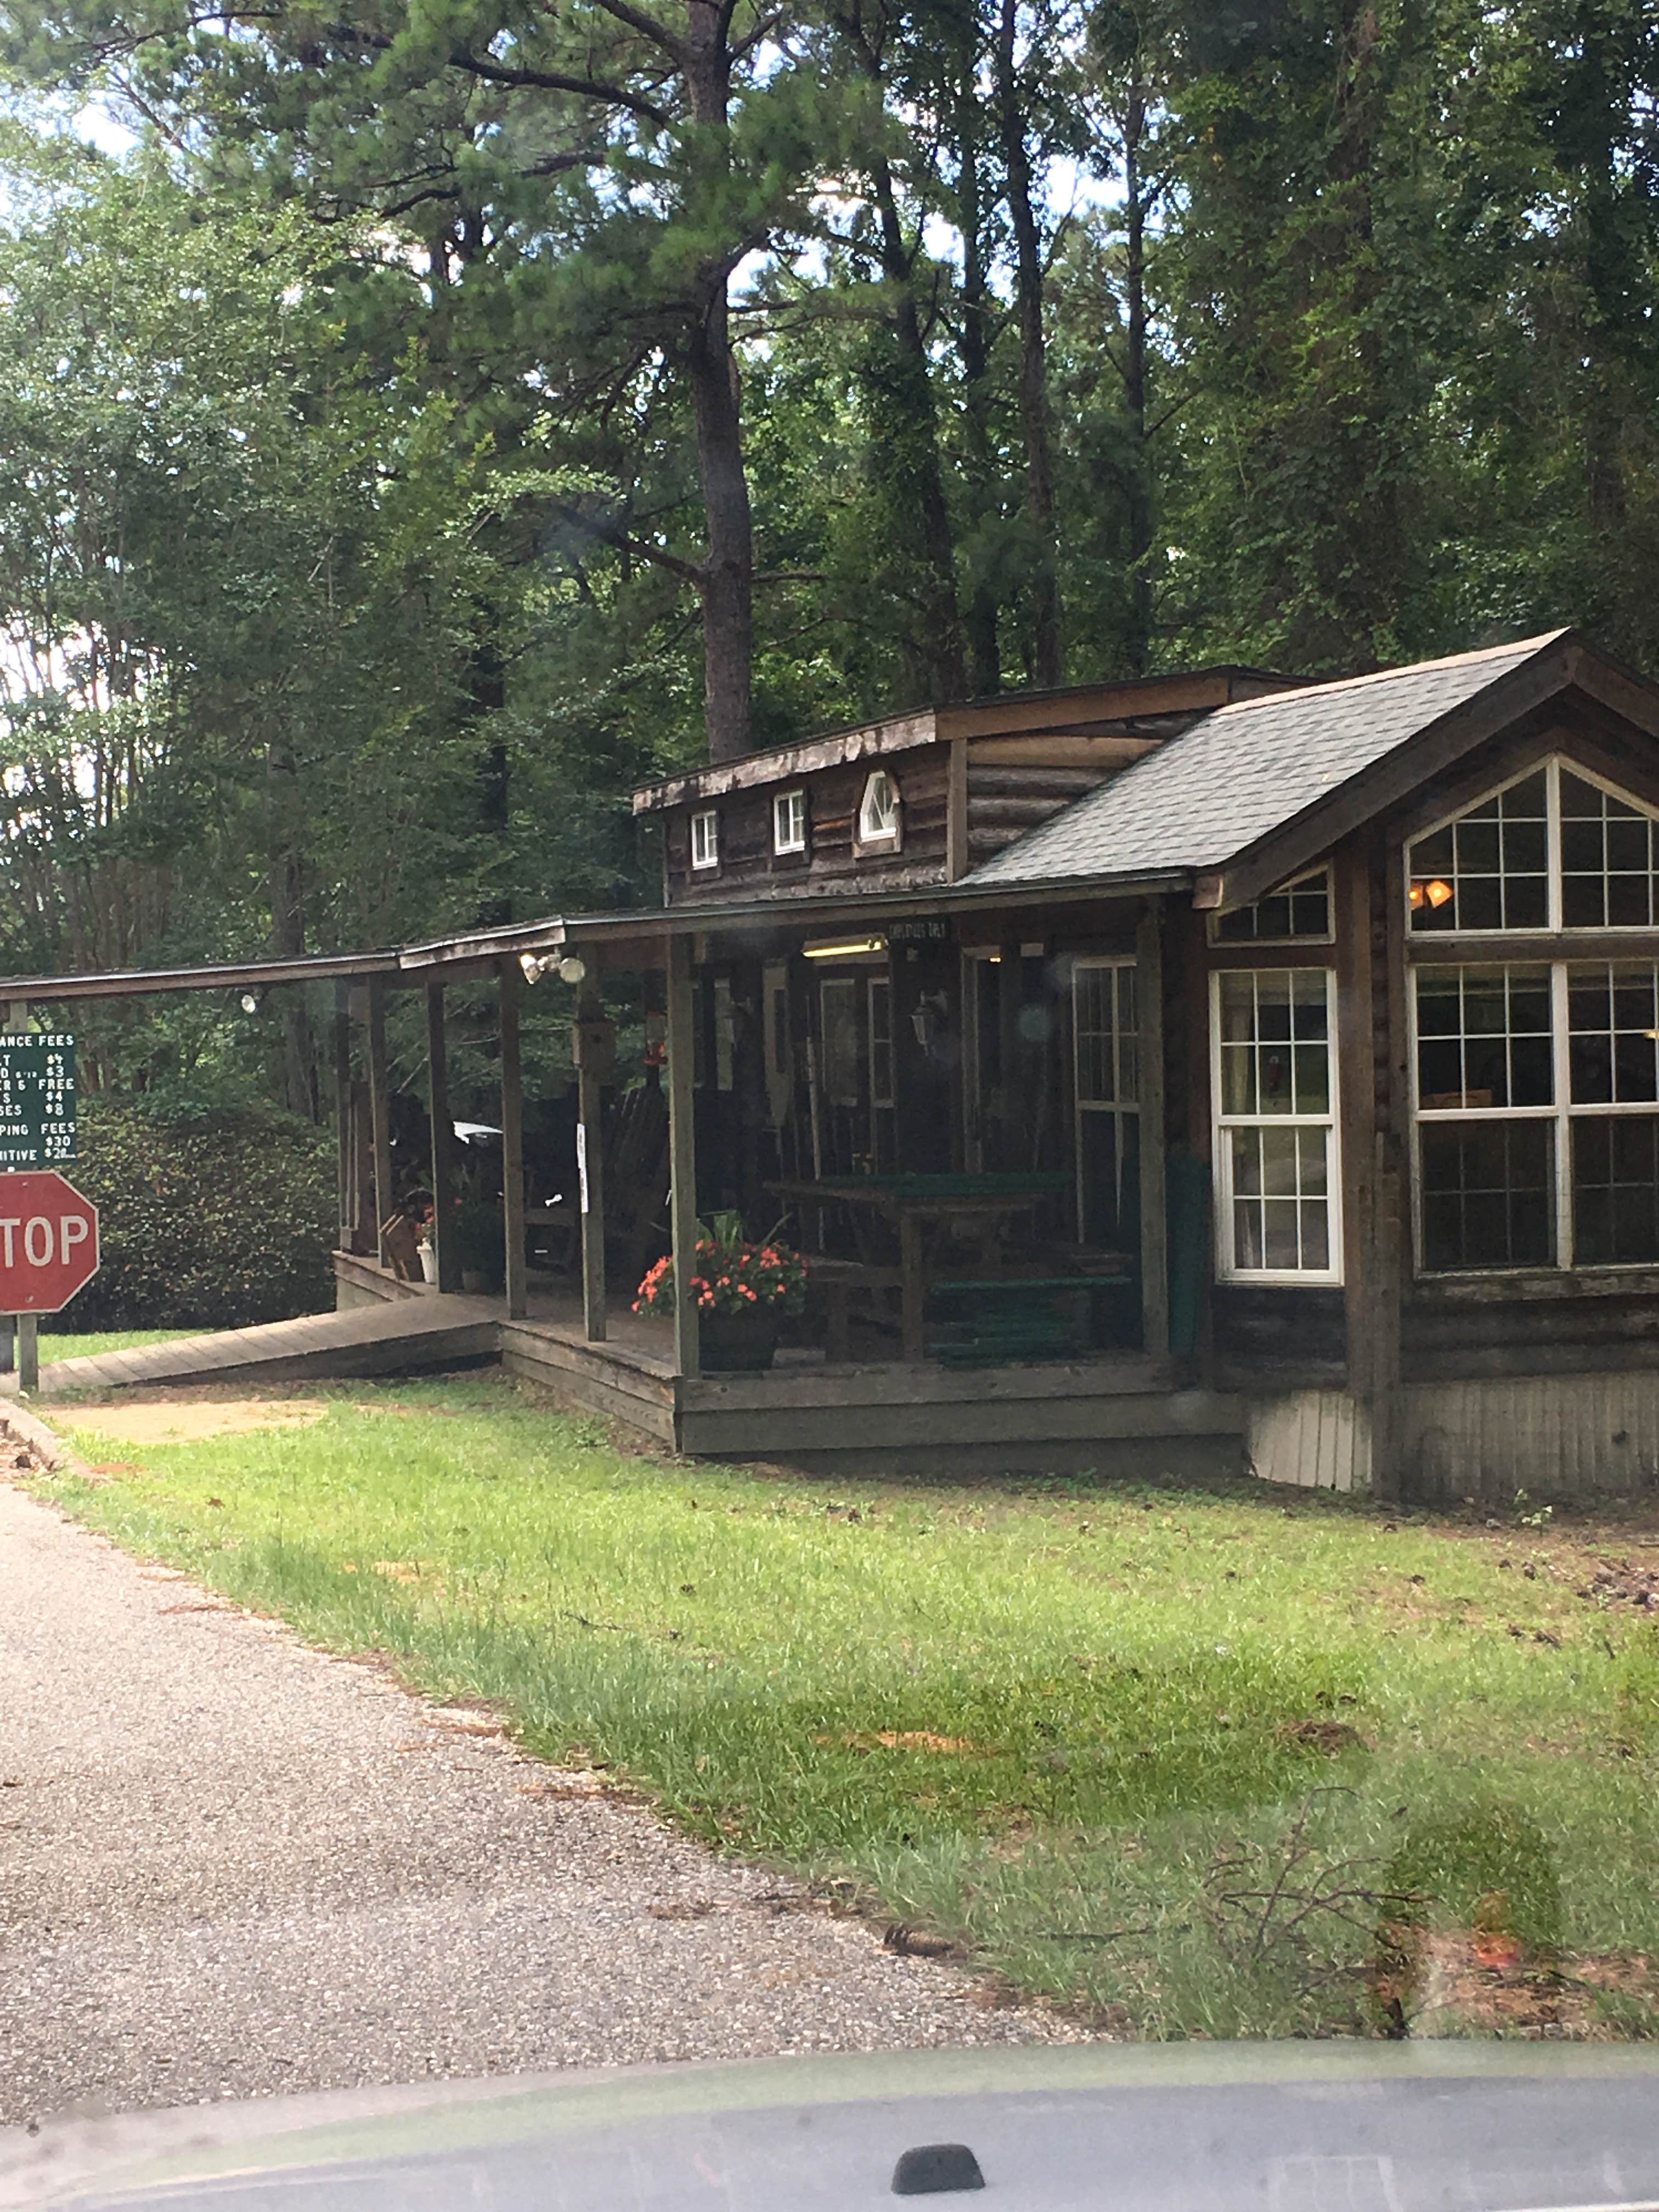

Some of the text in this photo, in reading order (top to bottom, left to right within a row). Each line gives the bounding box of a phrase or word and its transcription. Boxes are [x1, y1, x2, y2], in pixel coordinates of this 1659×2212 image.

[38, 1034, 74, 1047] FEES
[0, 1053, 64, 1066] T $4
[46, 1065, 64, 1077] $3
[18, 1080, 26, 1091] 6
[38, 1077, 75, 1090] FREE
[45, 1091, 63, 1102] $4
[45, 1103, 64, 1116] $8
[41, 1121, 76, 1135] FEES
[45, 1135, 71, 1147] $30
[0, 1215, 88, 1268] TOP
